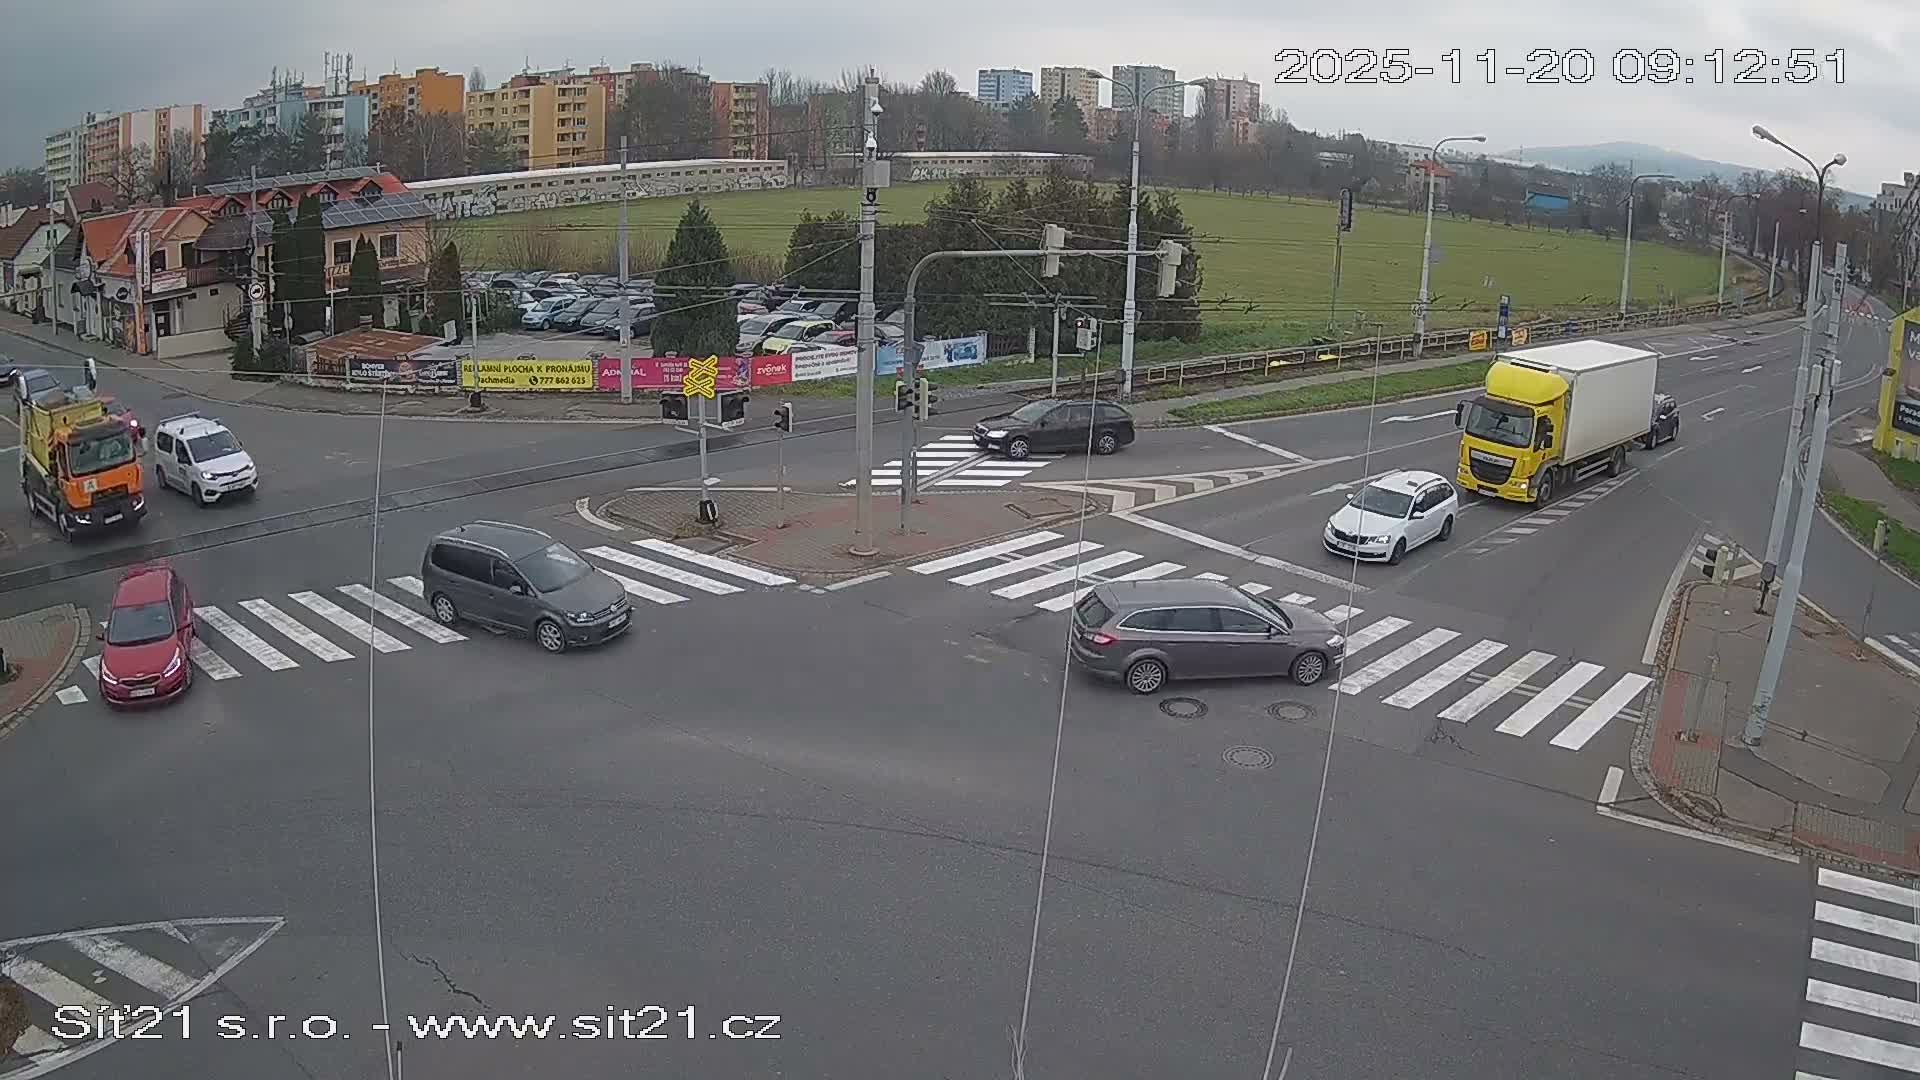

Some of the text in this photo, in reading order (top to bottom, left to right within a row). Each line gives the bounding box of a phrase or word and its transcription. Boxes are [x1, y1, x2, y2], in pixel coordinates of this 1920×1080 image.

[463, 364, 501, 373] RELAMNÍ
[503, 365, 534, 374] PLOCHA
[545, 363, 590, 373] PRONÁJMU
[540, 376, 554, 385] 777
[572, 376, 586, 385] 625
